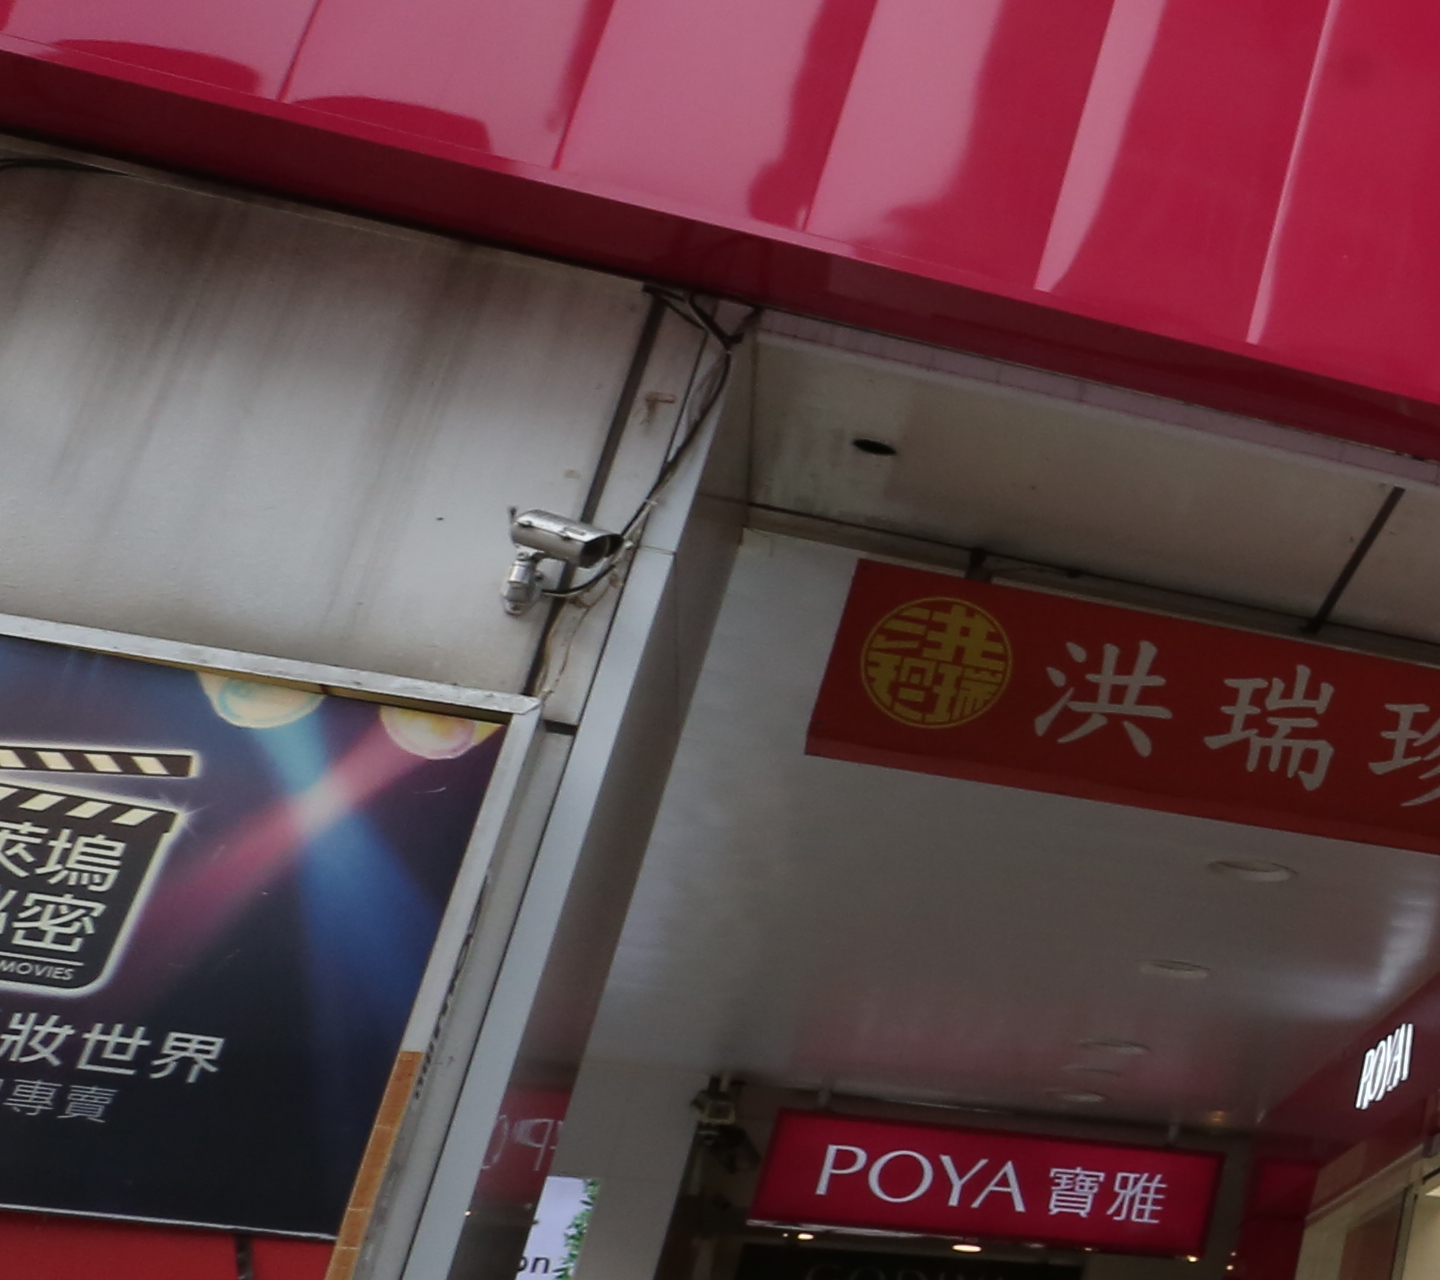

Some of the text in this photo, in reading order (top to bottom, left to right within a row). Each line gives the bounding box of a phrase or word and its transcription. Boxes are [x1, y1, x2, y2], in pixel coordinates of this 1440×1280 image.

[0, 888, 108, 954] 密
[814, 1143, 1169, 1225] POYA 寶雅
